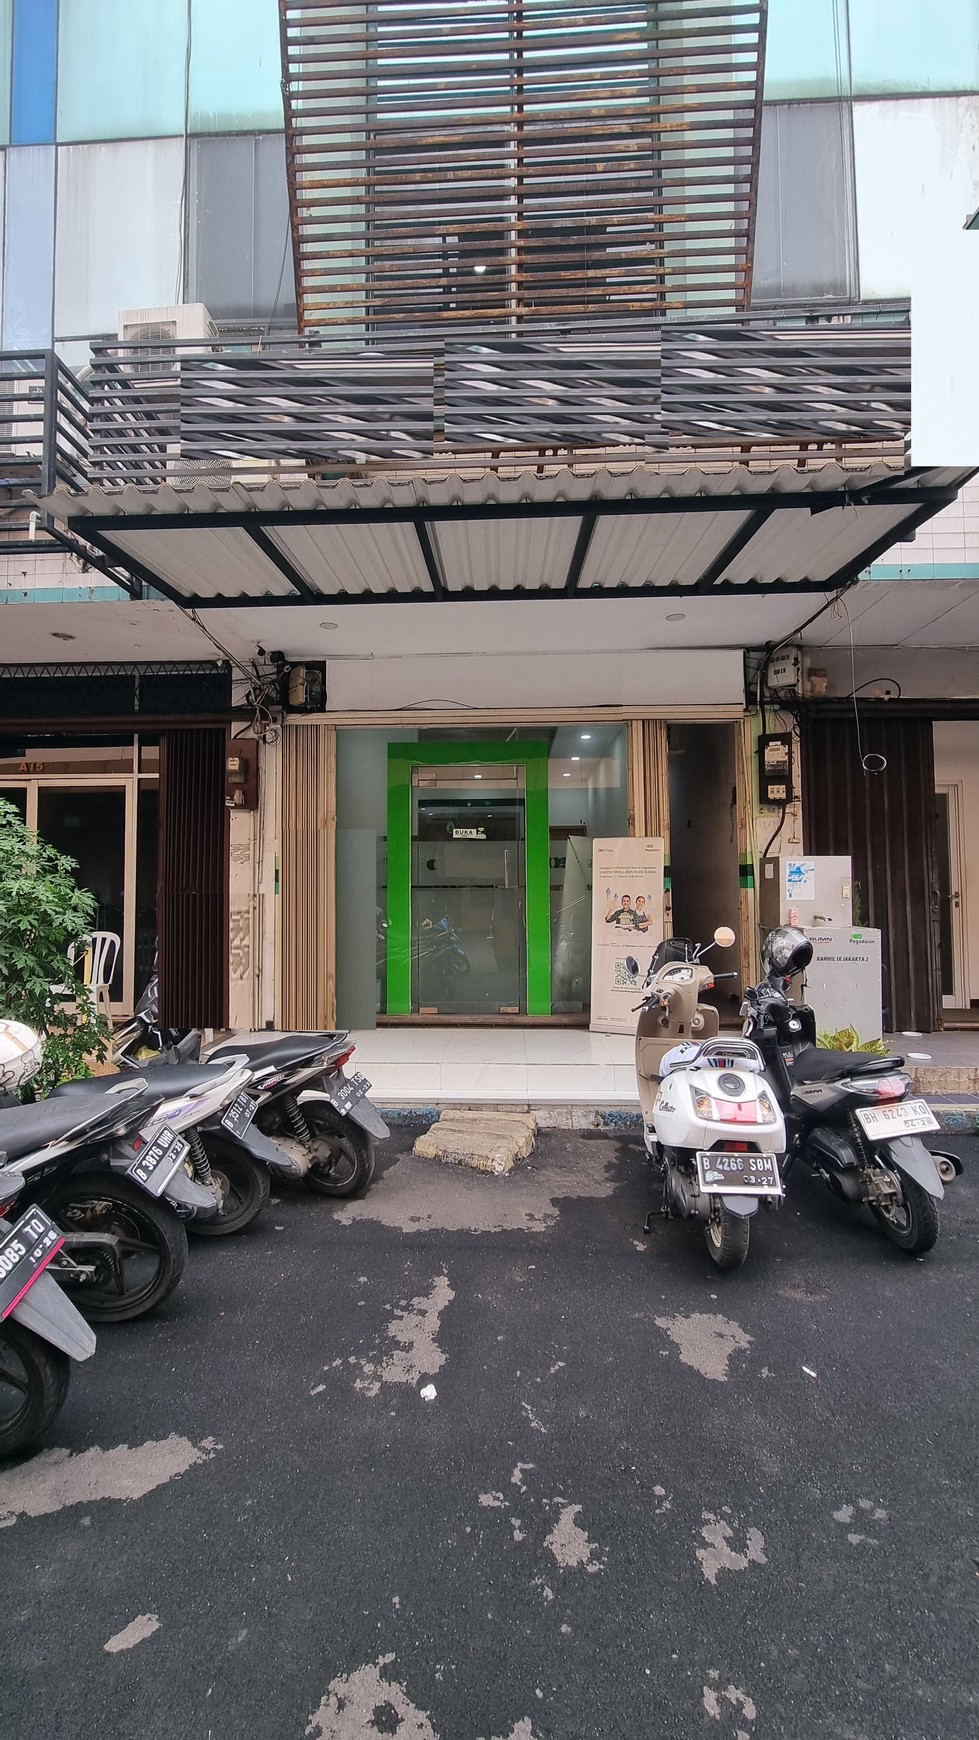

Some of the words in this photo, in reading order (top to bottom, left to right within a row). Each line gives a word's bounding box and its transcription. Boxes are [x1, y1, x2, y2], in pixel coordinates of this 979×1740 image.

[330, 1098, 339, 1107] B
[338, 1083, 354, 1100] 3004
[224, 1118, 234, 1128] B
[229, 1103, 243, 1121] 3512
[863, 1112, 879, 1124] BH
[882, 1107, 908, 1120] 6243
[135, 1168, 147, 1181] B
[141, 1145, 163, 1171] 3876
[157, 1129, 175, 1148] UHR
[702, 1157, 710, 1170] B
[716, 1158, 744, 1171] 4266
